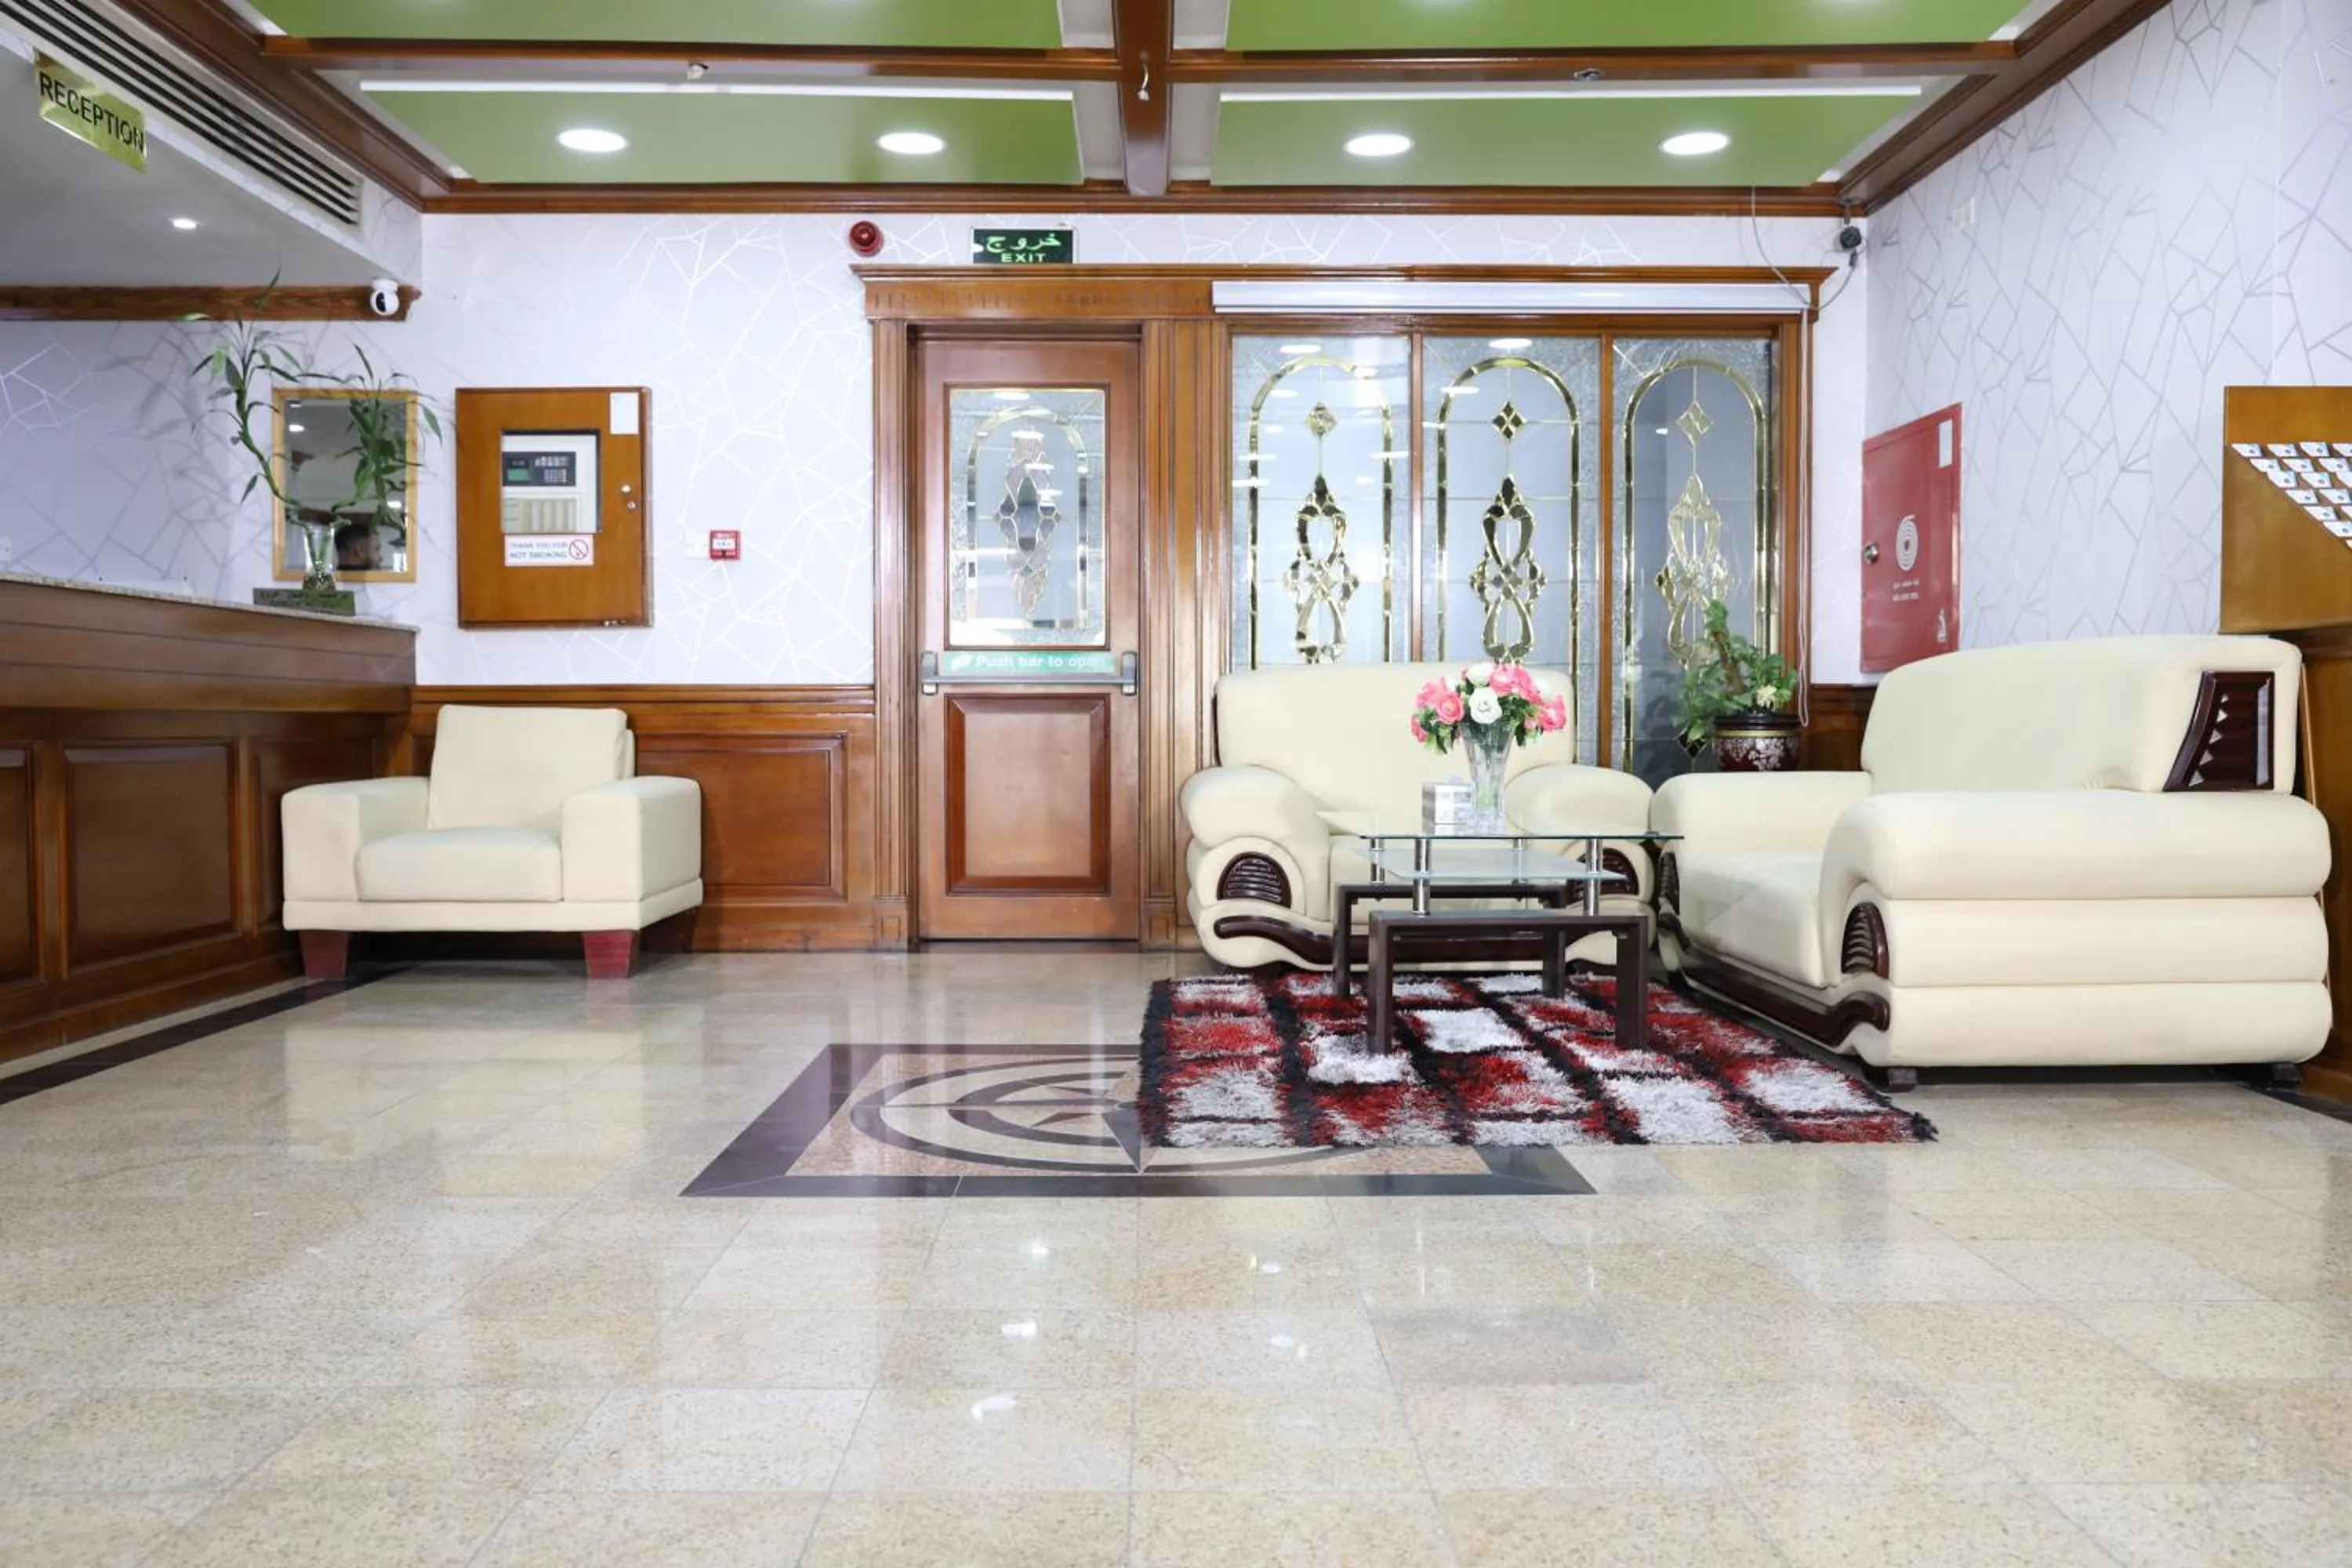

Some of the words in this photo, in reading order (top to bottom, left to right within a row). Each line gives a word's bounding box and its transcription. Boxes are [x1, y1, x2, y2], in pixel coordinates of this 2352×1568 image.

[39, 71, 143, 154] RECEPTION
[986, 233, 1062, 253] خروج
[1001, 253, 1046, 263] EXIT
[975, 655, 1014, 667] Push
[1018, 655, 1044, 667] bar
[1048, 655, 1063, 667] to
